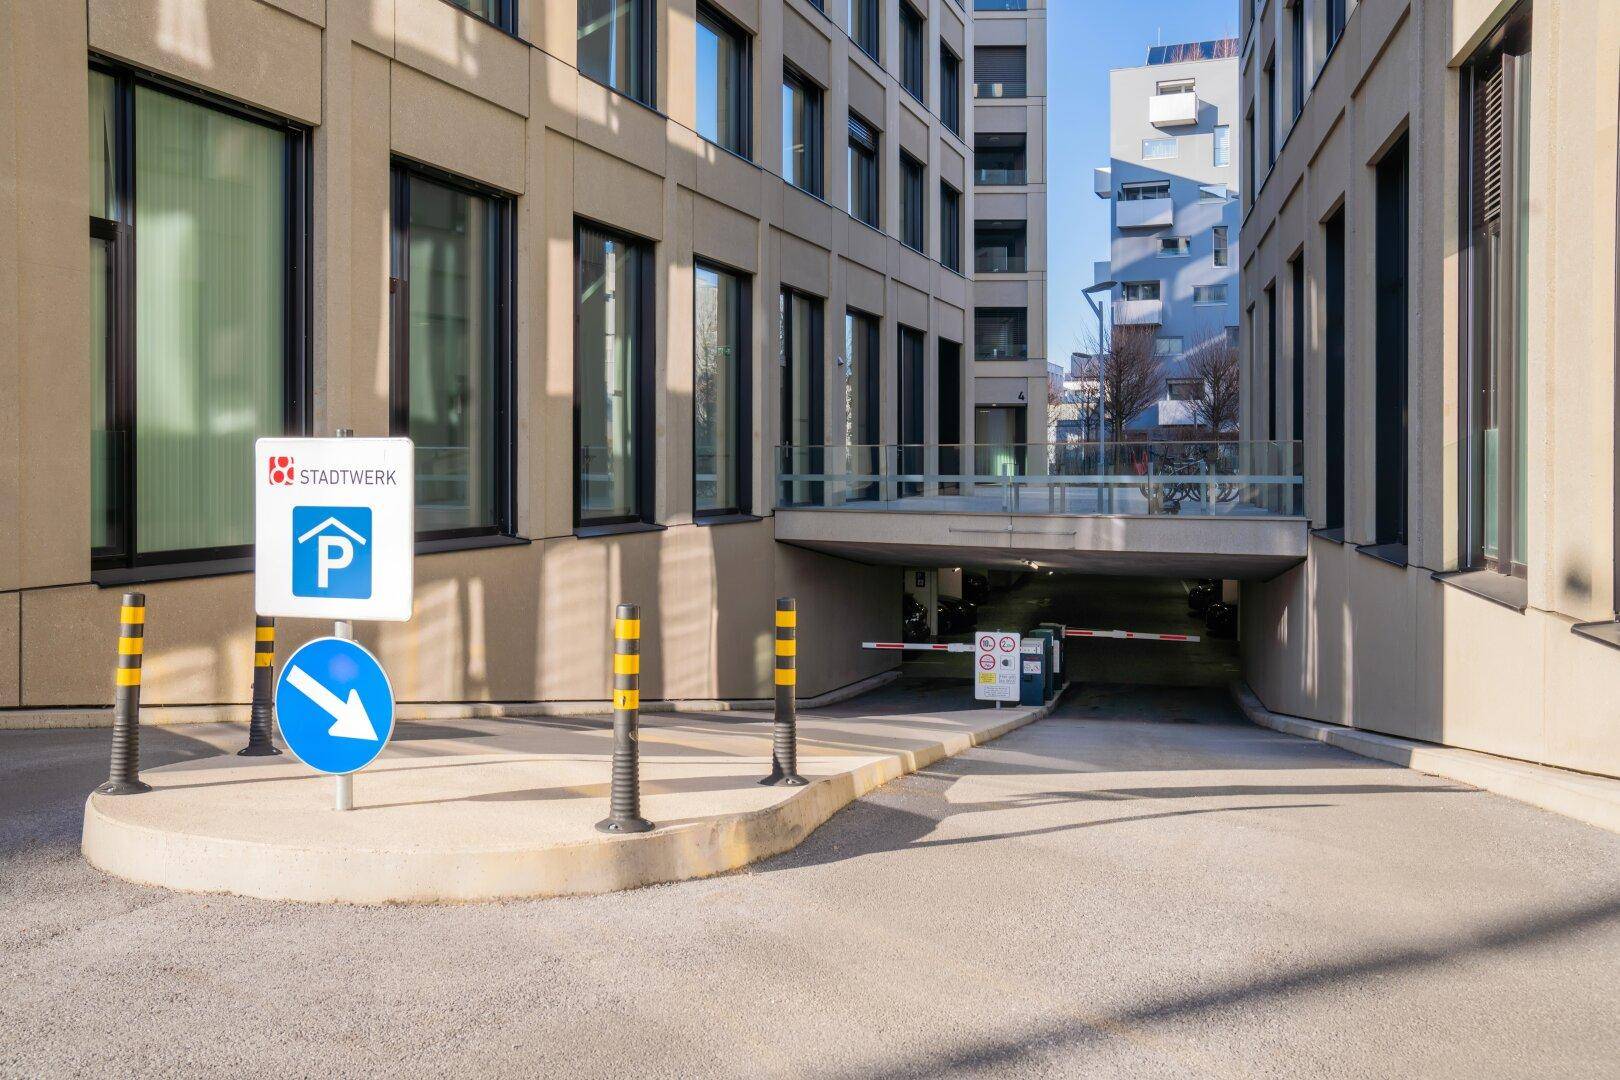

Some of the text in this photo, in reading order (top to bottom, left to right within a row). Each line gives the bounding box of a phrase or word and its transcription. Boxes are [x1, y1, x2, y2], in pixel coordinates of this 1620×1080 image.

[1018, 391, 1025, 401] 4
[300, 469, 397, 485] STADTWERK
[318, 535, 354, 588] P
